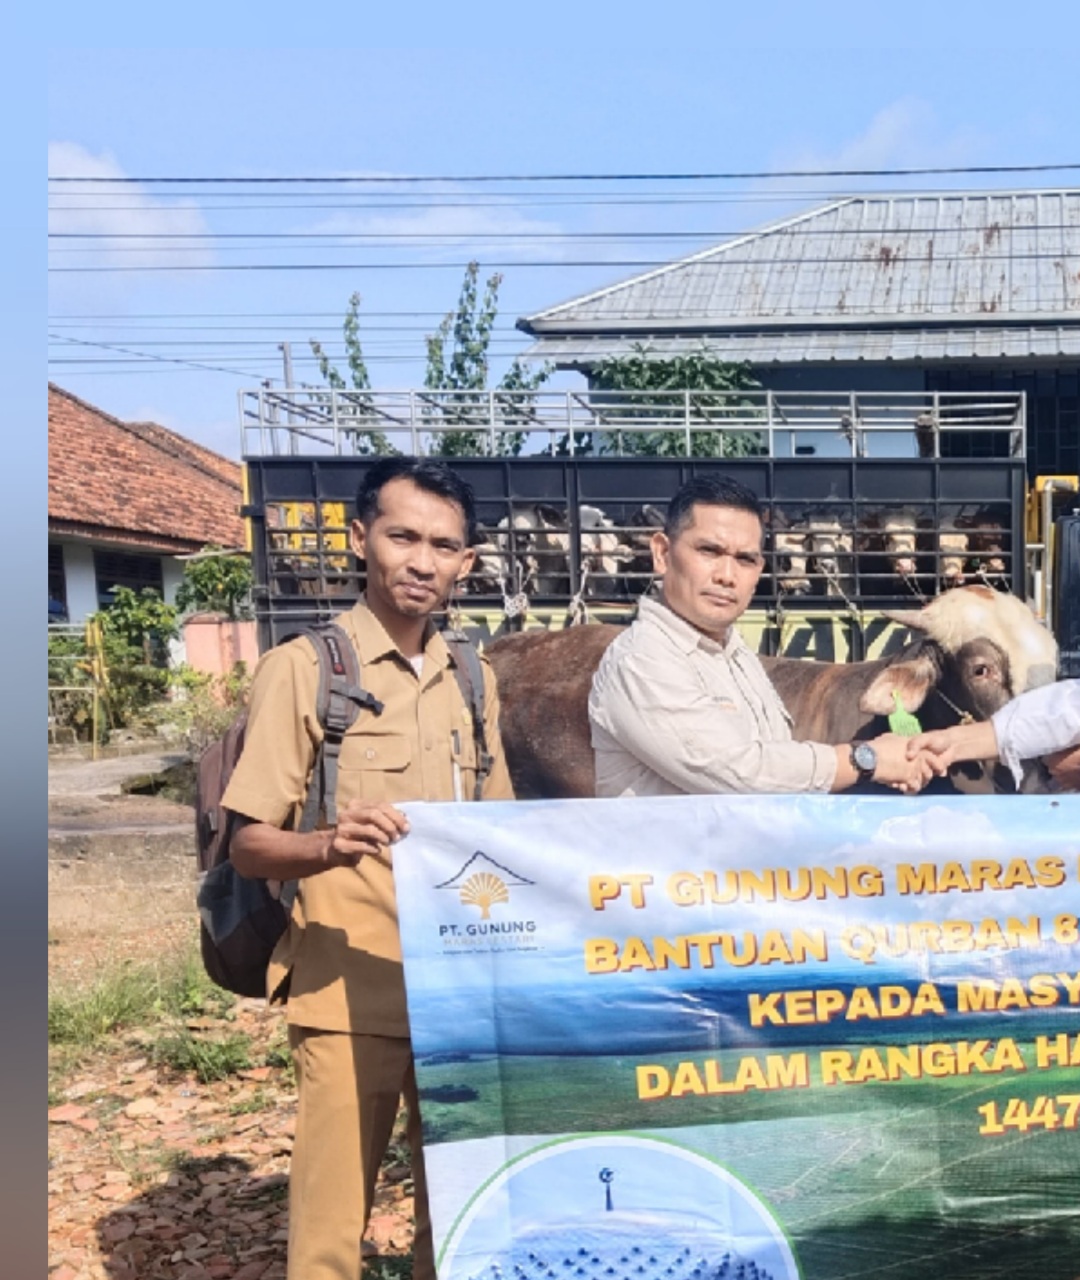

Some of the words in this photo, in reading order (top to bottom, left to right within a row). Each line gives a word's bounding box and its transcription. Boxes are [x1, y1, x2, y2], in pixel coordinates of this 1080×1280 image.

[588, 872, 653, 910] PT
[665, 864, 882, 907] GUNUNG
[897, 853, 1065, 897] MARAS
[440, 925, 462, 936] PT.
[466, 921, 536, 936] GUNUNG
[584, 925, 826, 974] BANTUAN
[839, 914, 1040, 963] QURBAN
[1053, 913, 1079, 945] 8
[747, 981, 943, 1027] KEPADA
[636, 1052, 806, 1100] DALAM
[820, 1036, 1024, 1085] RANGKA
